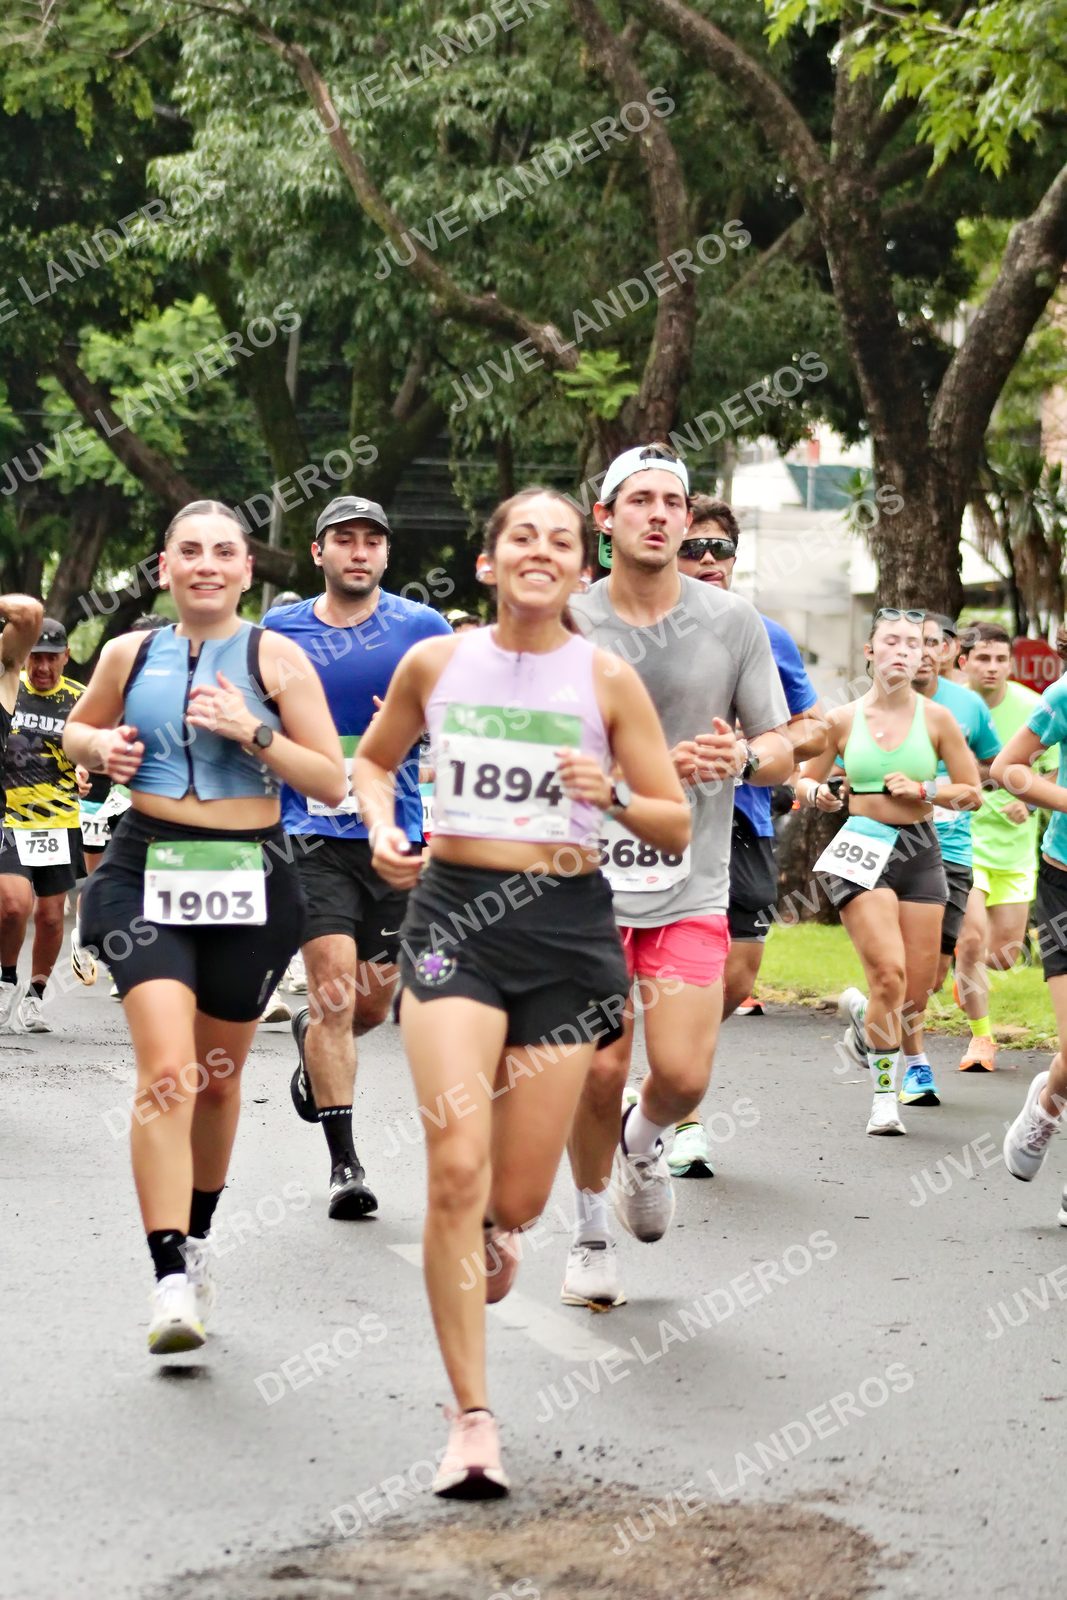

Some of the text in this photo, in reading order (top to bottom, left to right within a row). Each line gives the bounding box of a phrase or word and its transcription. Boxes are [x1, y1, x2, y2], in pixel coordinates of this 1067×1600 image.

[449, 759, 563, 807] 1894
[25, 838, 59, 854] 738
[157, 890, 255, 921] 1903
